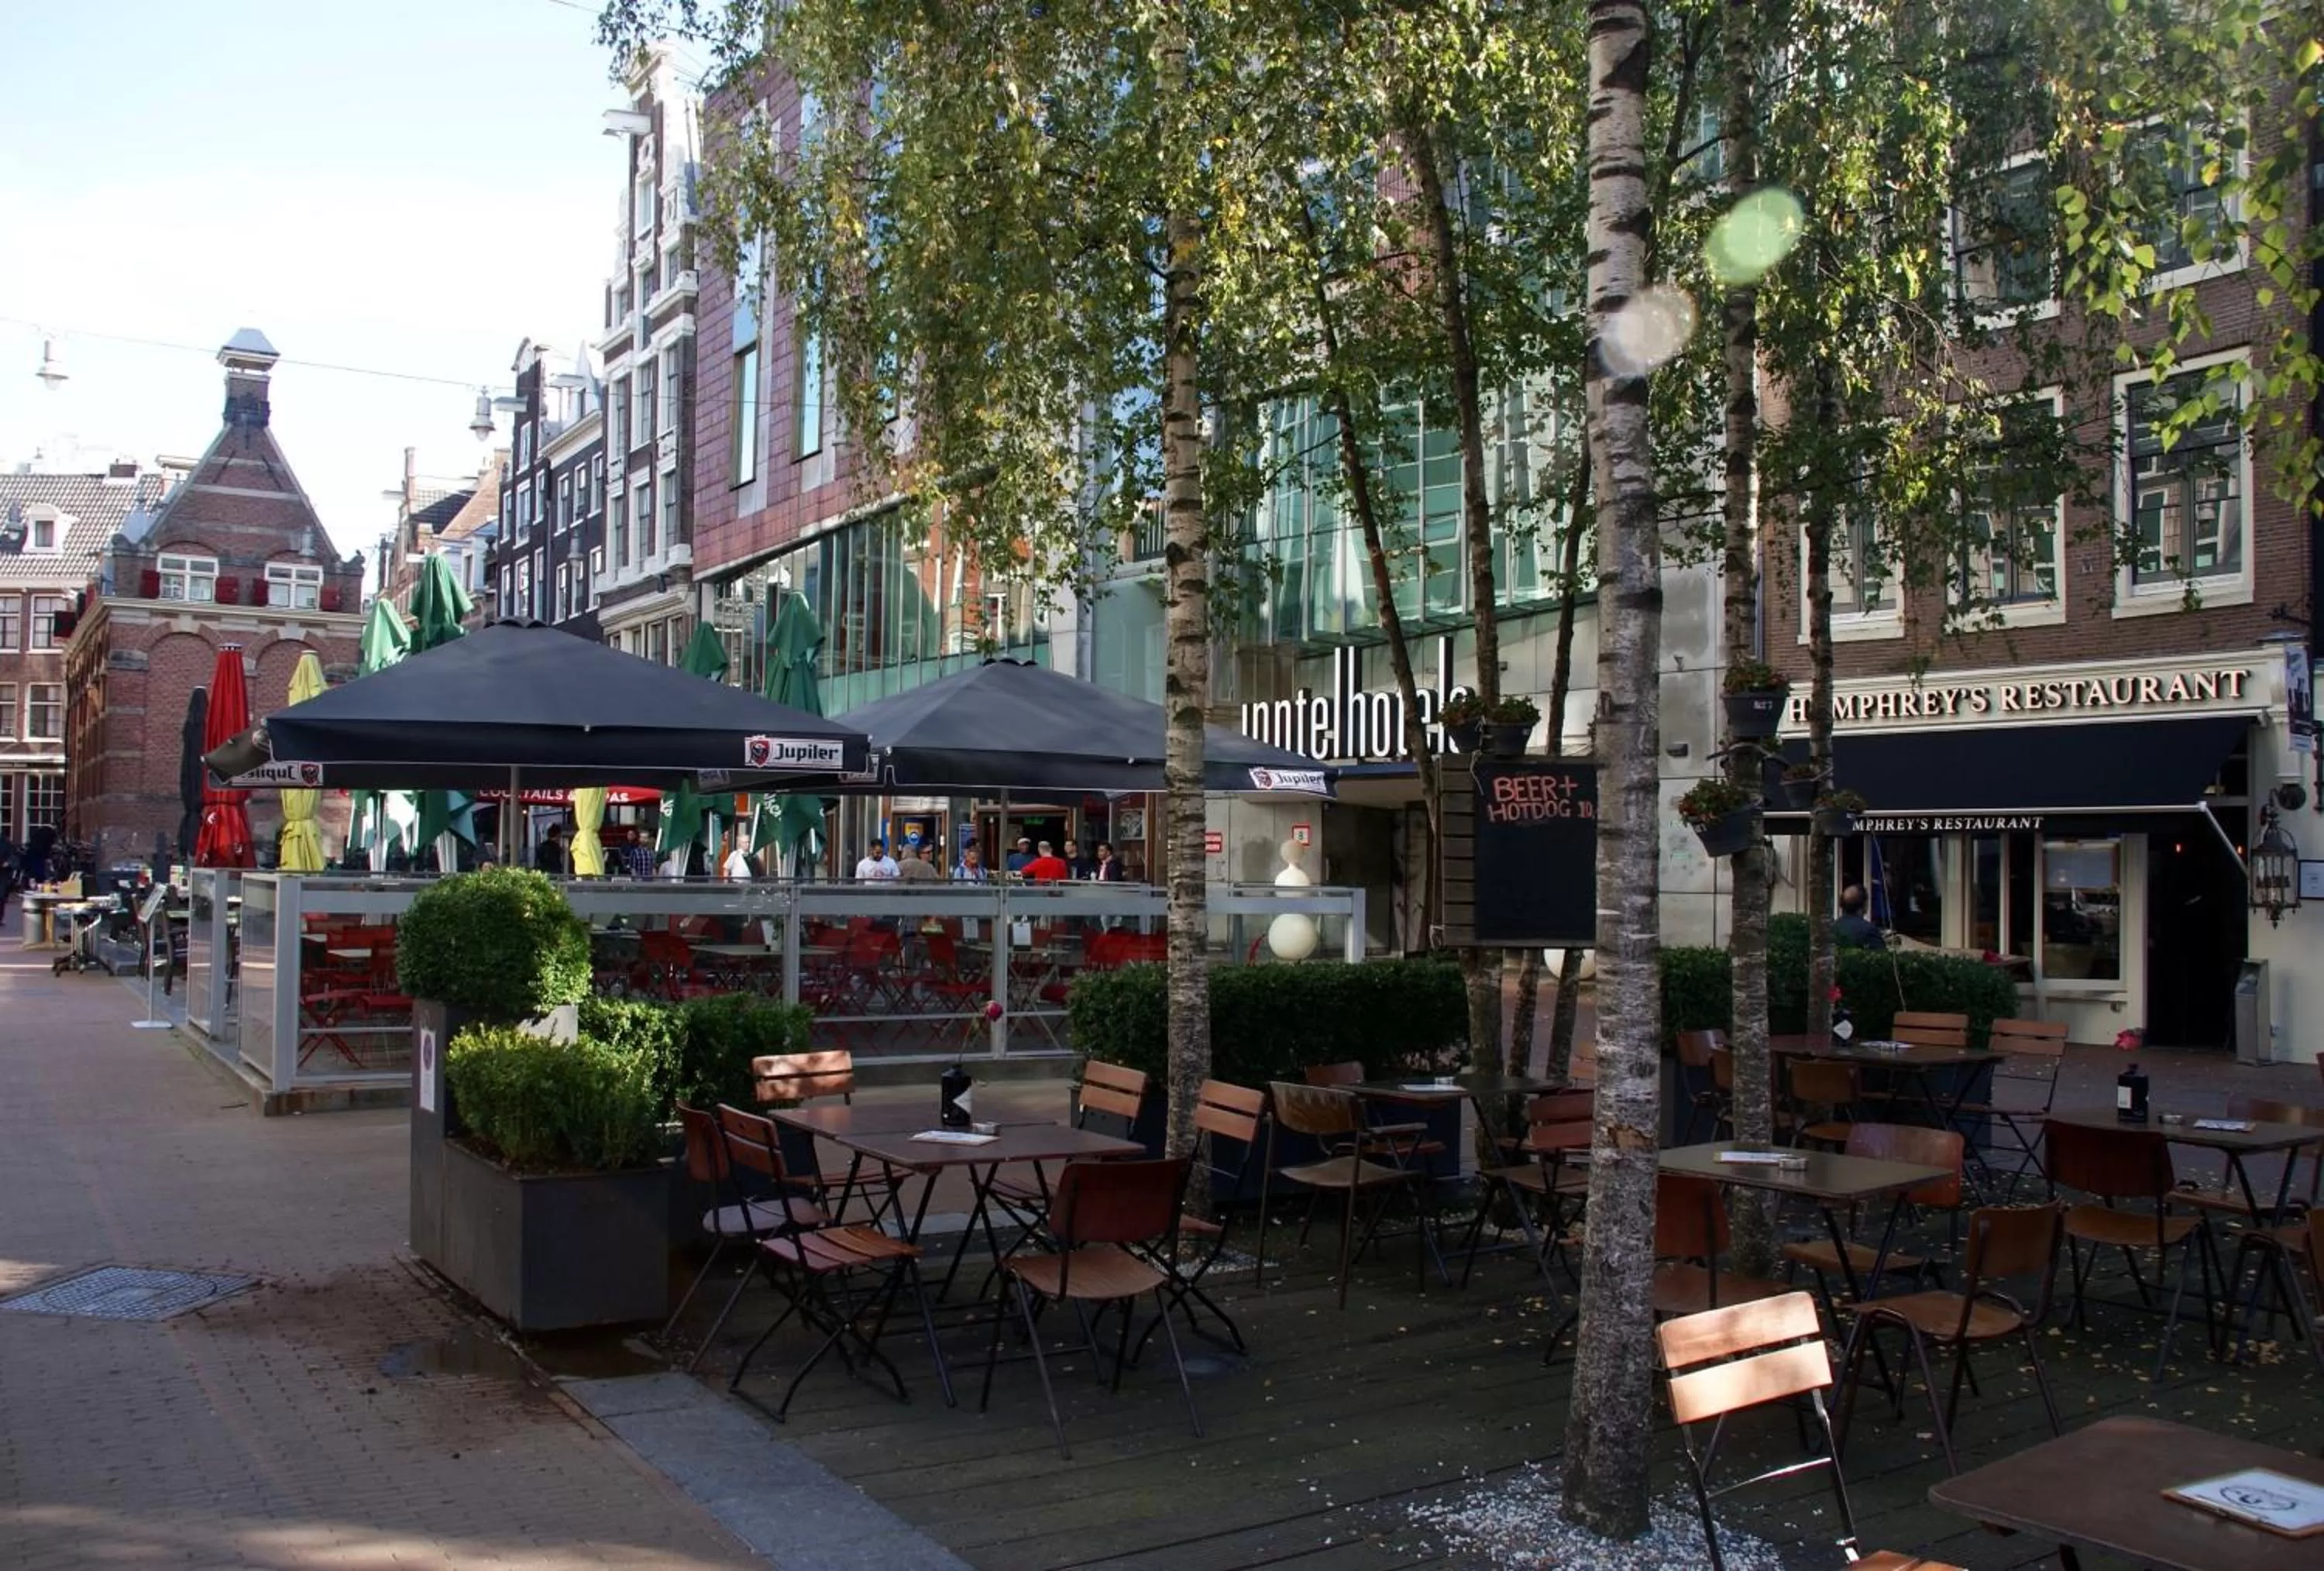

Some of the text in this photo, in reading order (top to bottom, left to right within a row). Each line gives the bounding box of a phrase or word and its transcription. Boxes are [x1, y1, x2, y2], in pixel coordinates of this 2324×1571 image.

[1789, 670, 2250, 722] HMPHREY'S RESTAURANT
[775, 744, 838, 761] Jupiler
[1277, 773, 1322, 786] Jupiler
[480, 789, 564, 800] COCTAILS
[1487, 799, 1571, 822] HOTDOG
[1852, 816, 2044, 831] MPHREY'S RESTAURANT
